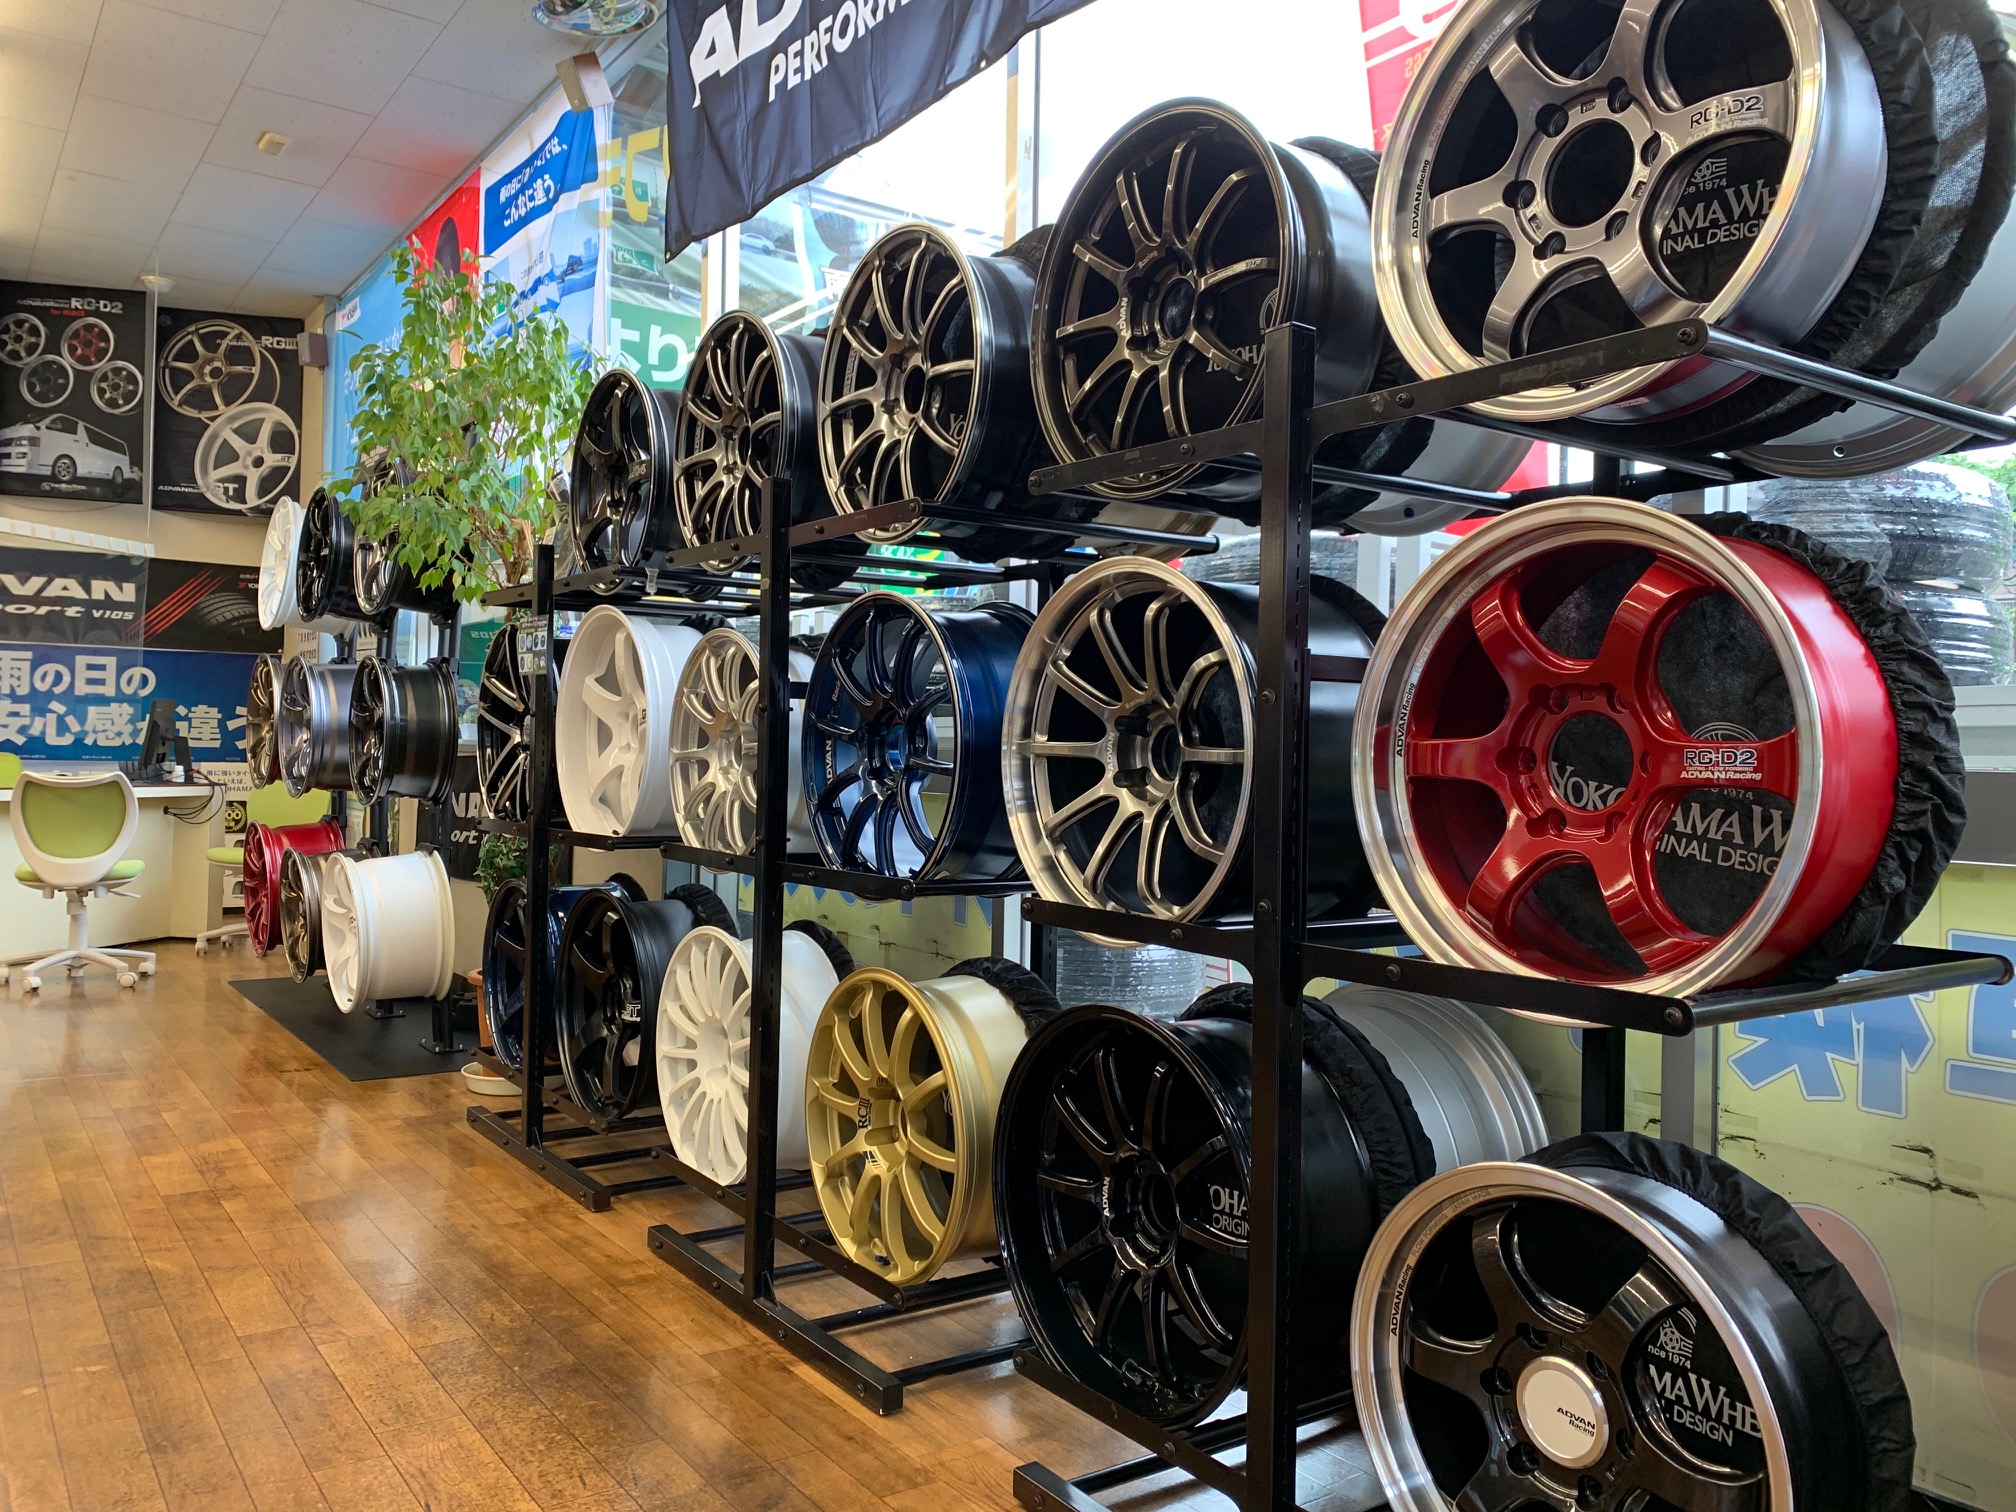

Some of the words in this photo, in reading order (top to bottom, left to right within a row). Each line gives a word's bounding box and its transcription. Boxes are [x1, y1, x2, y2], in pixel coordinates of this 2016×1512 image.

[1466, 45, 1486, 74] JAPAN
[1485, 21, 1507, 47] MADE
[1689, 94, 1764, 130] RG-D2
[1733, 117, 1768, 129] Racing
[1417, 159, 1430, 191] Racing
[1700, 177, 1728, 192] 1974
[1412, 191, 1423, 239] ADVAN
[1138, 250, 1158, 269] Racing
[71, 297, 123, 314] RG-D2
[1117, 297, 1131, 336] ADVAN
[0, 573, 136, 603] VAN
[0, 603, 85, 617] ort
[92, 609, 135, 620] V105
[1396, 712, 1408, 757] ADVAN
[1402, 682, 1416, 712] Racing
[1106, 732, 1115, 771] ADVAN
[1684, 749, 1757, 767] RG-D2
[1680, 771, 1727, 779] ADVAN
[1726, 772, 1762, 781] Racing
[1102, 1176, 1110, 1216] ADVAN
[1391, 1290, 1403, 1336] ADVAN
[1398, 1264, 1412, 1291] Racing
[1668, 1352, 1691, 1369] 1974
[1557, 1407, 1595, 1430] ADVAN
[1569, 1419, 1594, 1437] Racing
[1673, 1405, 1733, 1447] DESIGN
